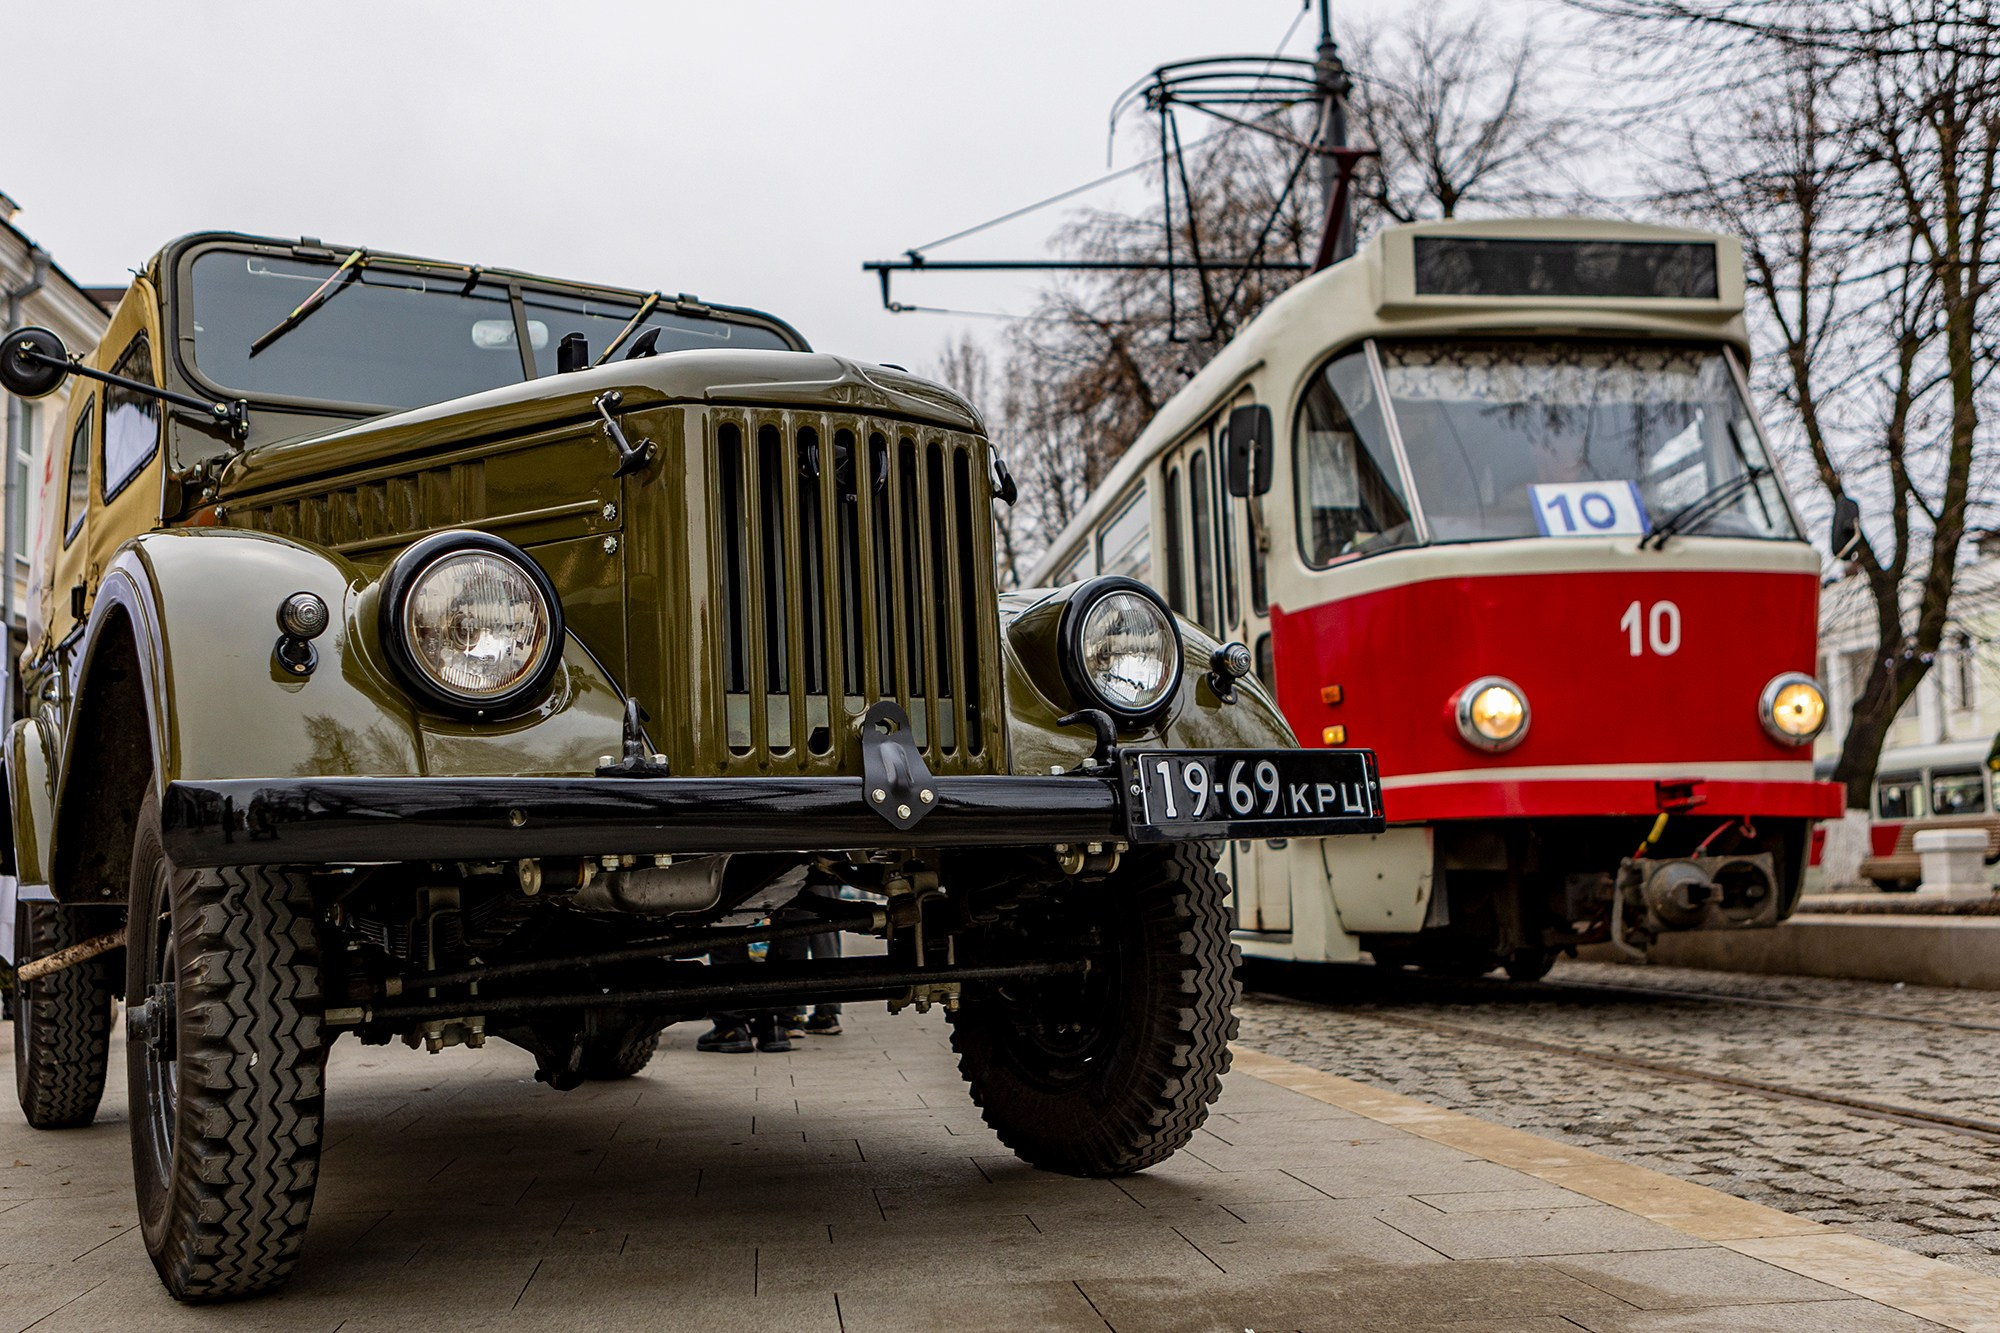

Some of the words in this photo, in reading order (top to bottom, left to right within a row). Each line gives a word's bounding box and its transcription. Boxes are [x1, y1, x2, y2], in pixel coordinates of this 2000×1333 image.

[1547, 492, 1616, 531] 10
[1620, 600, 1681, 656] 10
[1156, 760, 1280, 818] 19-69
[1290, 783, 1365, 814] КРЦ
